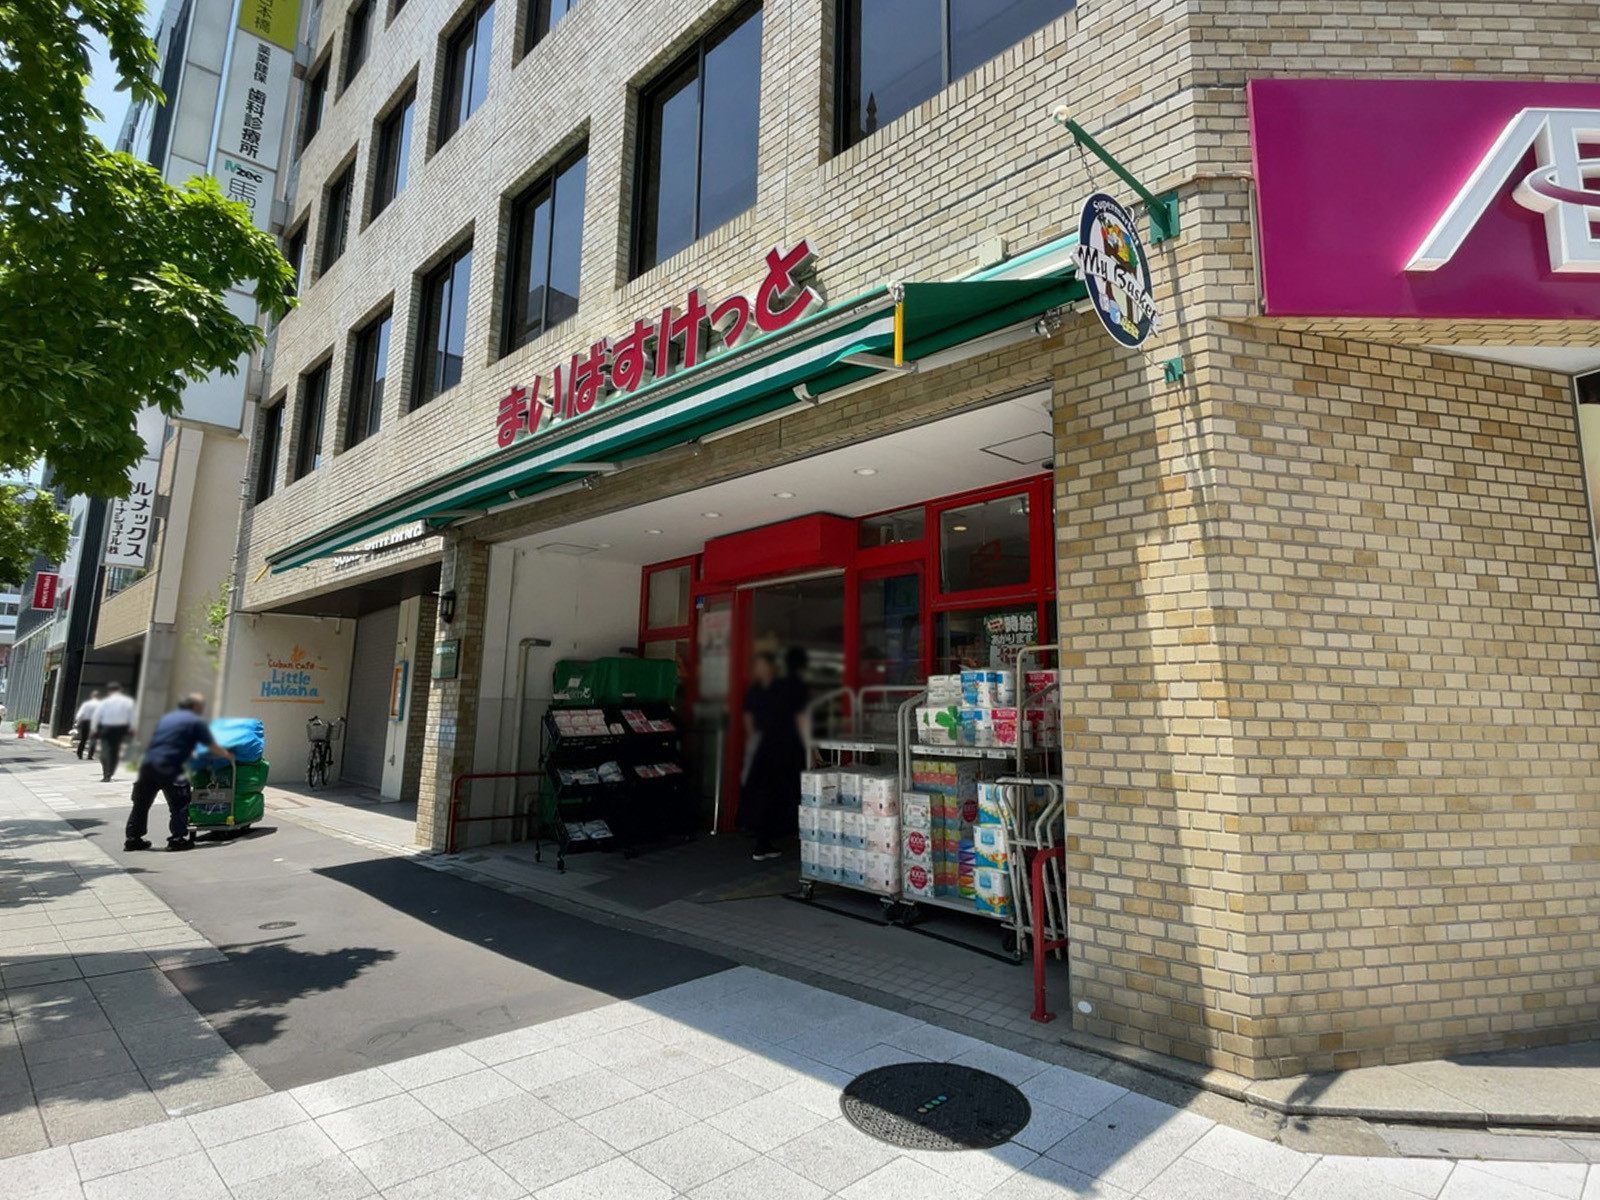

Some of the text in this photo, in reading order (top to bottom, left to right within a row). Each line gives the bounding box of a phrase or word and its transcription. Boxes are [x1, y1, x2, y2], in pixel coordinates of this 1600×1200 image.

[239, 87, 267, 159] 歯科診療所
[1077, 246, 1159, 322] My Basket
[496, 237, 824, 449] まいばすけっと
[123, 482, 153, 559] ルメックス
[271, 668, 311, 686] Little
